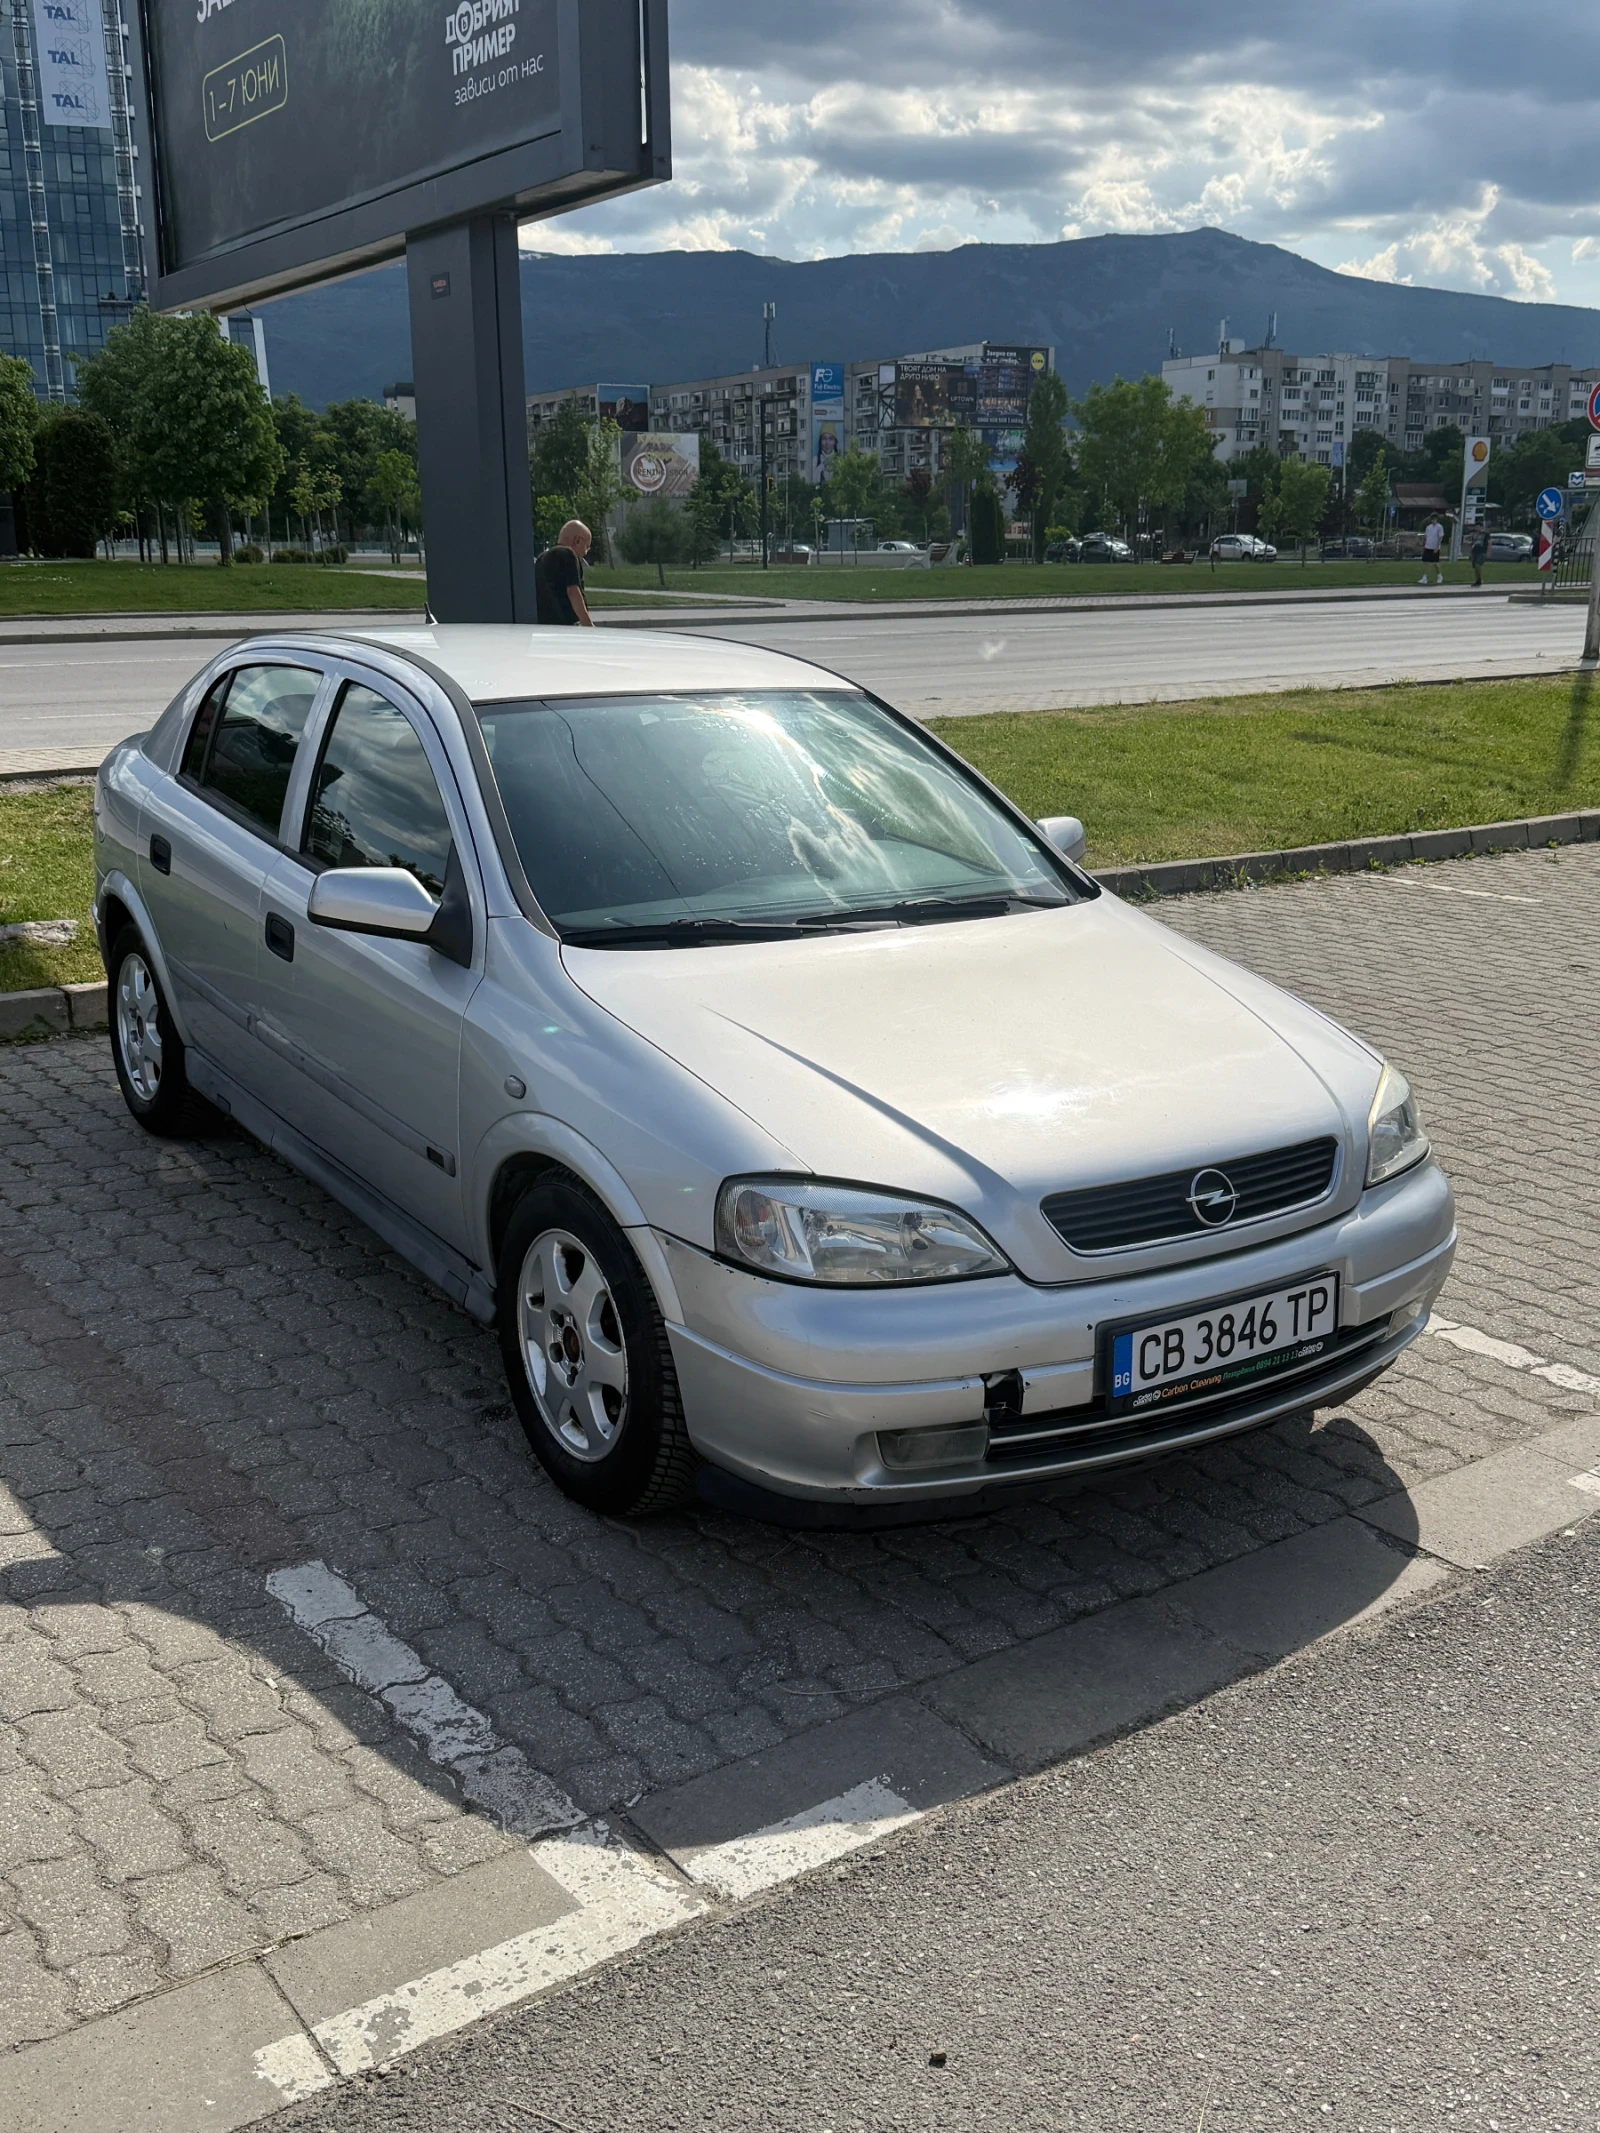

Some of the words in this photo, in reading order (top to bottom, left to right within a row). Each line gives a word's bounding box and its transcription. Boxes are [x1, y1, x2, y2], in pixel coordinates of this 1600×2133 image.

[43, 5, 77, 21] TAL
[47, 50, 81, 65] TAL
[452, 23, 516, 76] ПРИМЕР
[241, 54, 280, 106] ЮНИ
[454, 77, 496, 106] зависи
[498, 65, 519, 87] от
[521, 54, 544, 78] нас
[52, 93, 85, 109] TAL
[900, 365, 921, 373] ТВОЯТ
[921, 366, 937, 374] ДОМ
[900, 373, 921, 381] ДРУГО
[1140, 1328, 1185, 1380] CB
[1193, 1300, 1278, 1365] 3846
[1287, 1286, 1329, 1337] TP
[1113, 1371, 1131, 1389] BG
[1161, 1383, 1189, 1398] Carbon
[1189, 1374, 1222, 1390] Cleaning
